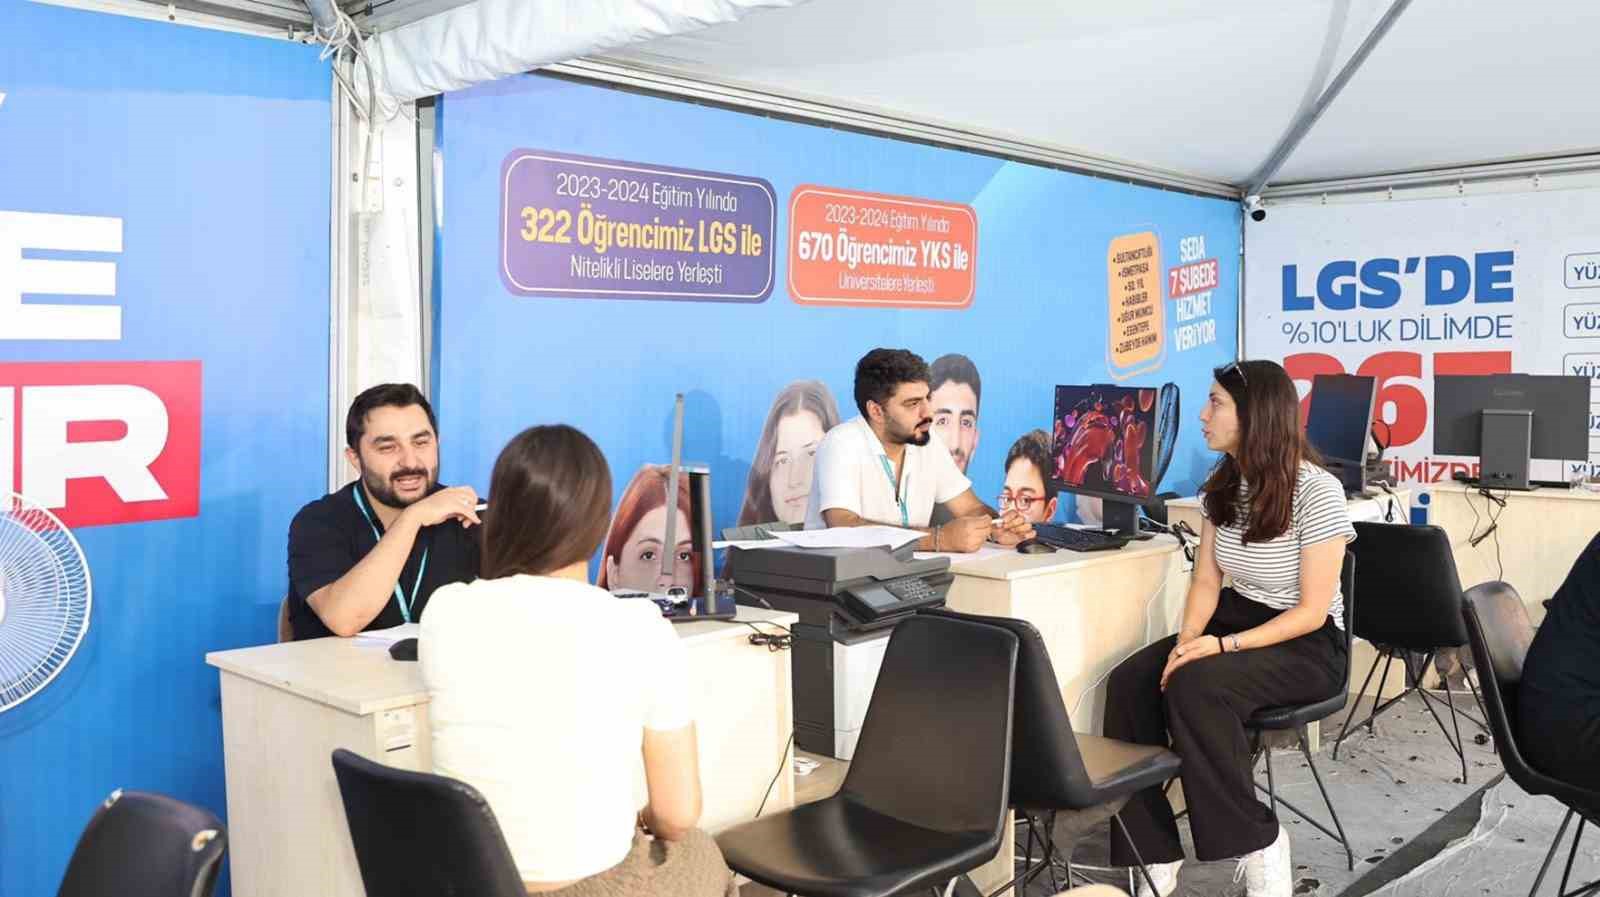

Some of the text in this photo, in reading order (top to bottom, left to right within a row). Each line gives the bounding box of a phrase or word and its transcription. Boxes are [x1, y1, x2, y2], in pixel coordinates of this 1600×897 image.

[556, 172, 737, 212] 2023-2024 Eğitim Yılında
[520, 203, 762, 256] 322 Öğrencimiz LGS ile
[825, 203, 888, 226] 2023-2024
[799, 228, 968, 271] 670 Öğrencimiz YKS ile
[1180, 236, 1206, 262] SEDA
[570, 255, 722, 285] Nitelikli Liselere Yerleşti
[1170, 271, 1178, 295] 7
[1282, 250, 1514, 312] LGS'DE
[1574, 261, 1600, 281] YÜ
[1282, 313, 1513, 344] %10'LUK DİLİMDE
[1573, 311, 1600, 331] YÜ
[0, 384, 169, 510] R
